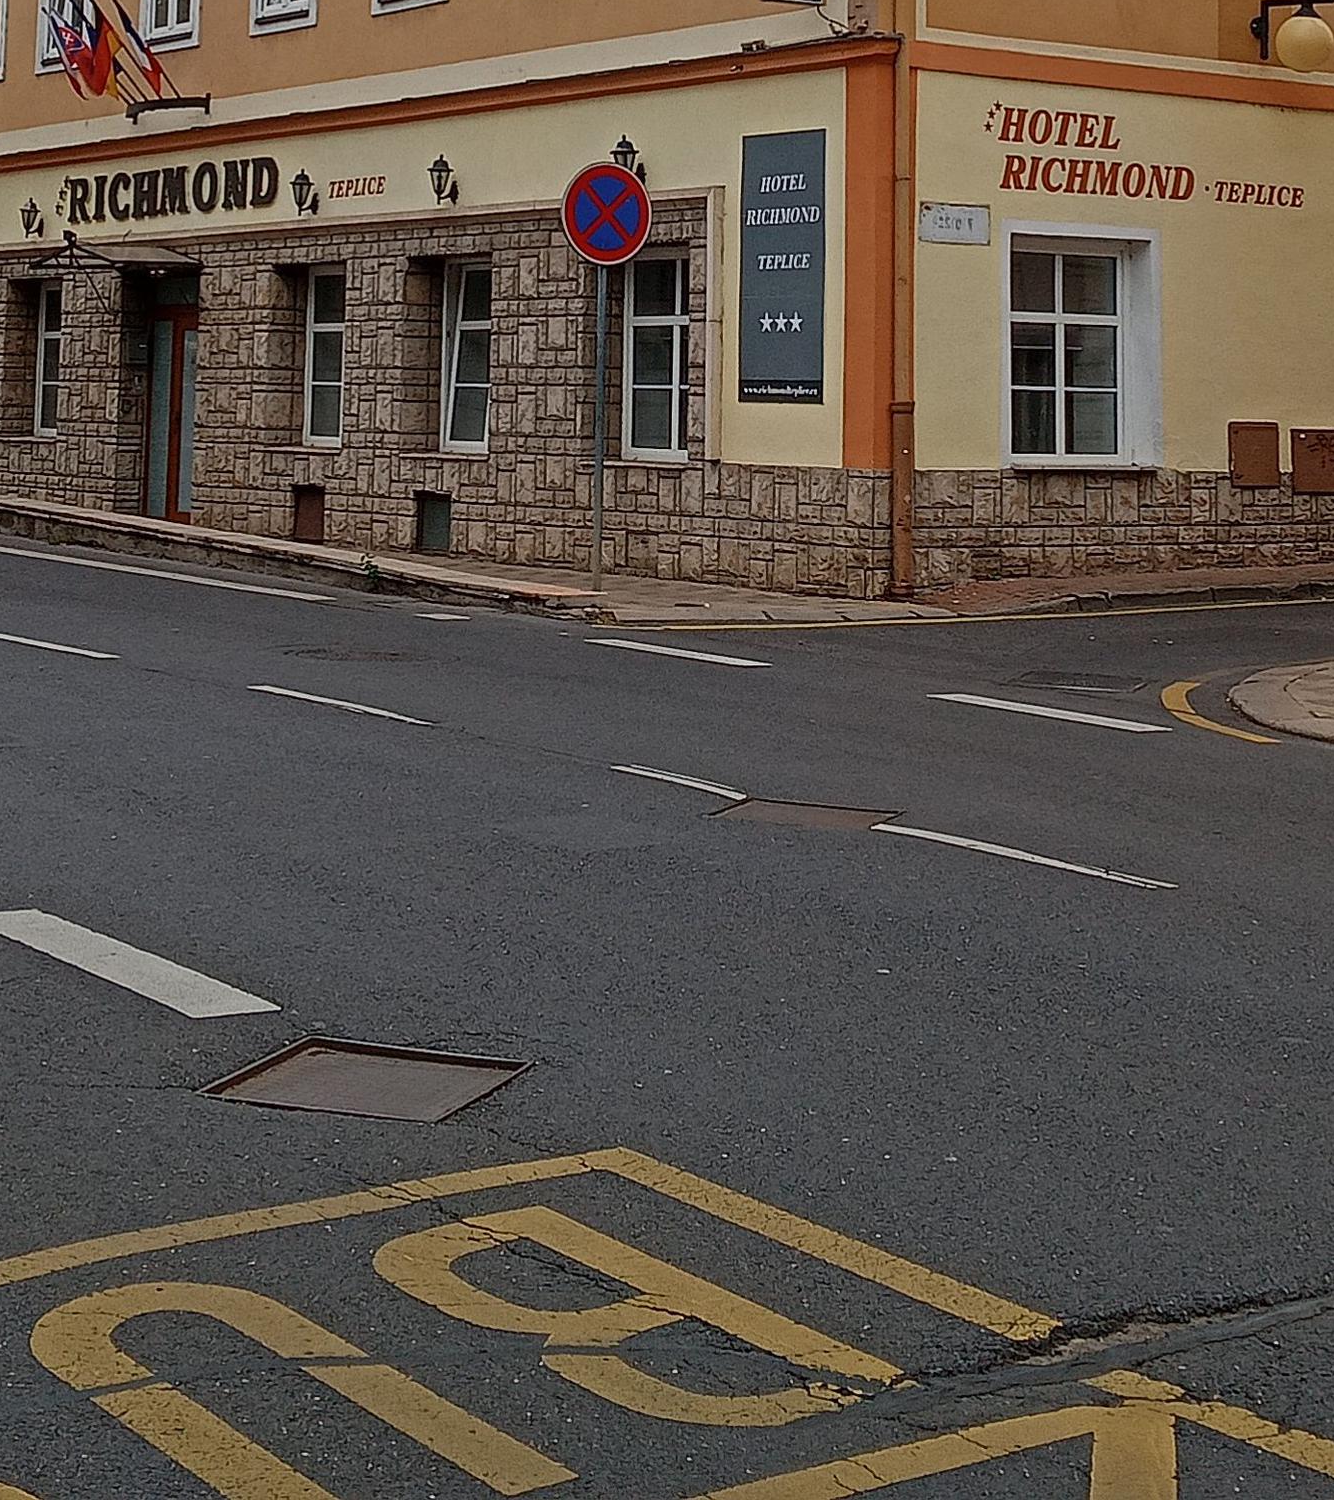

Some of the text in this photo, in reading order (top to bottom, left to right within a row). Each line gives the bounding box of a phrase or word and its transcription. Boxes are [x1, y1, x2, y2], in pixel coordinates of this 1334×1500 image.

[997, 106, 1121, 150] HOTEL
[66, 156, 386, 225] RICHMOND TEPLICE
[760, 173, 807, 193] HOTEL
[999, 154, 1305, 208] RICHMOND TEPLICE
[745, 206, 821, 226] RICHMOND
[757, 253, 811, 271] TEPLICE
